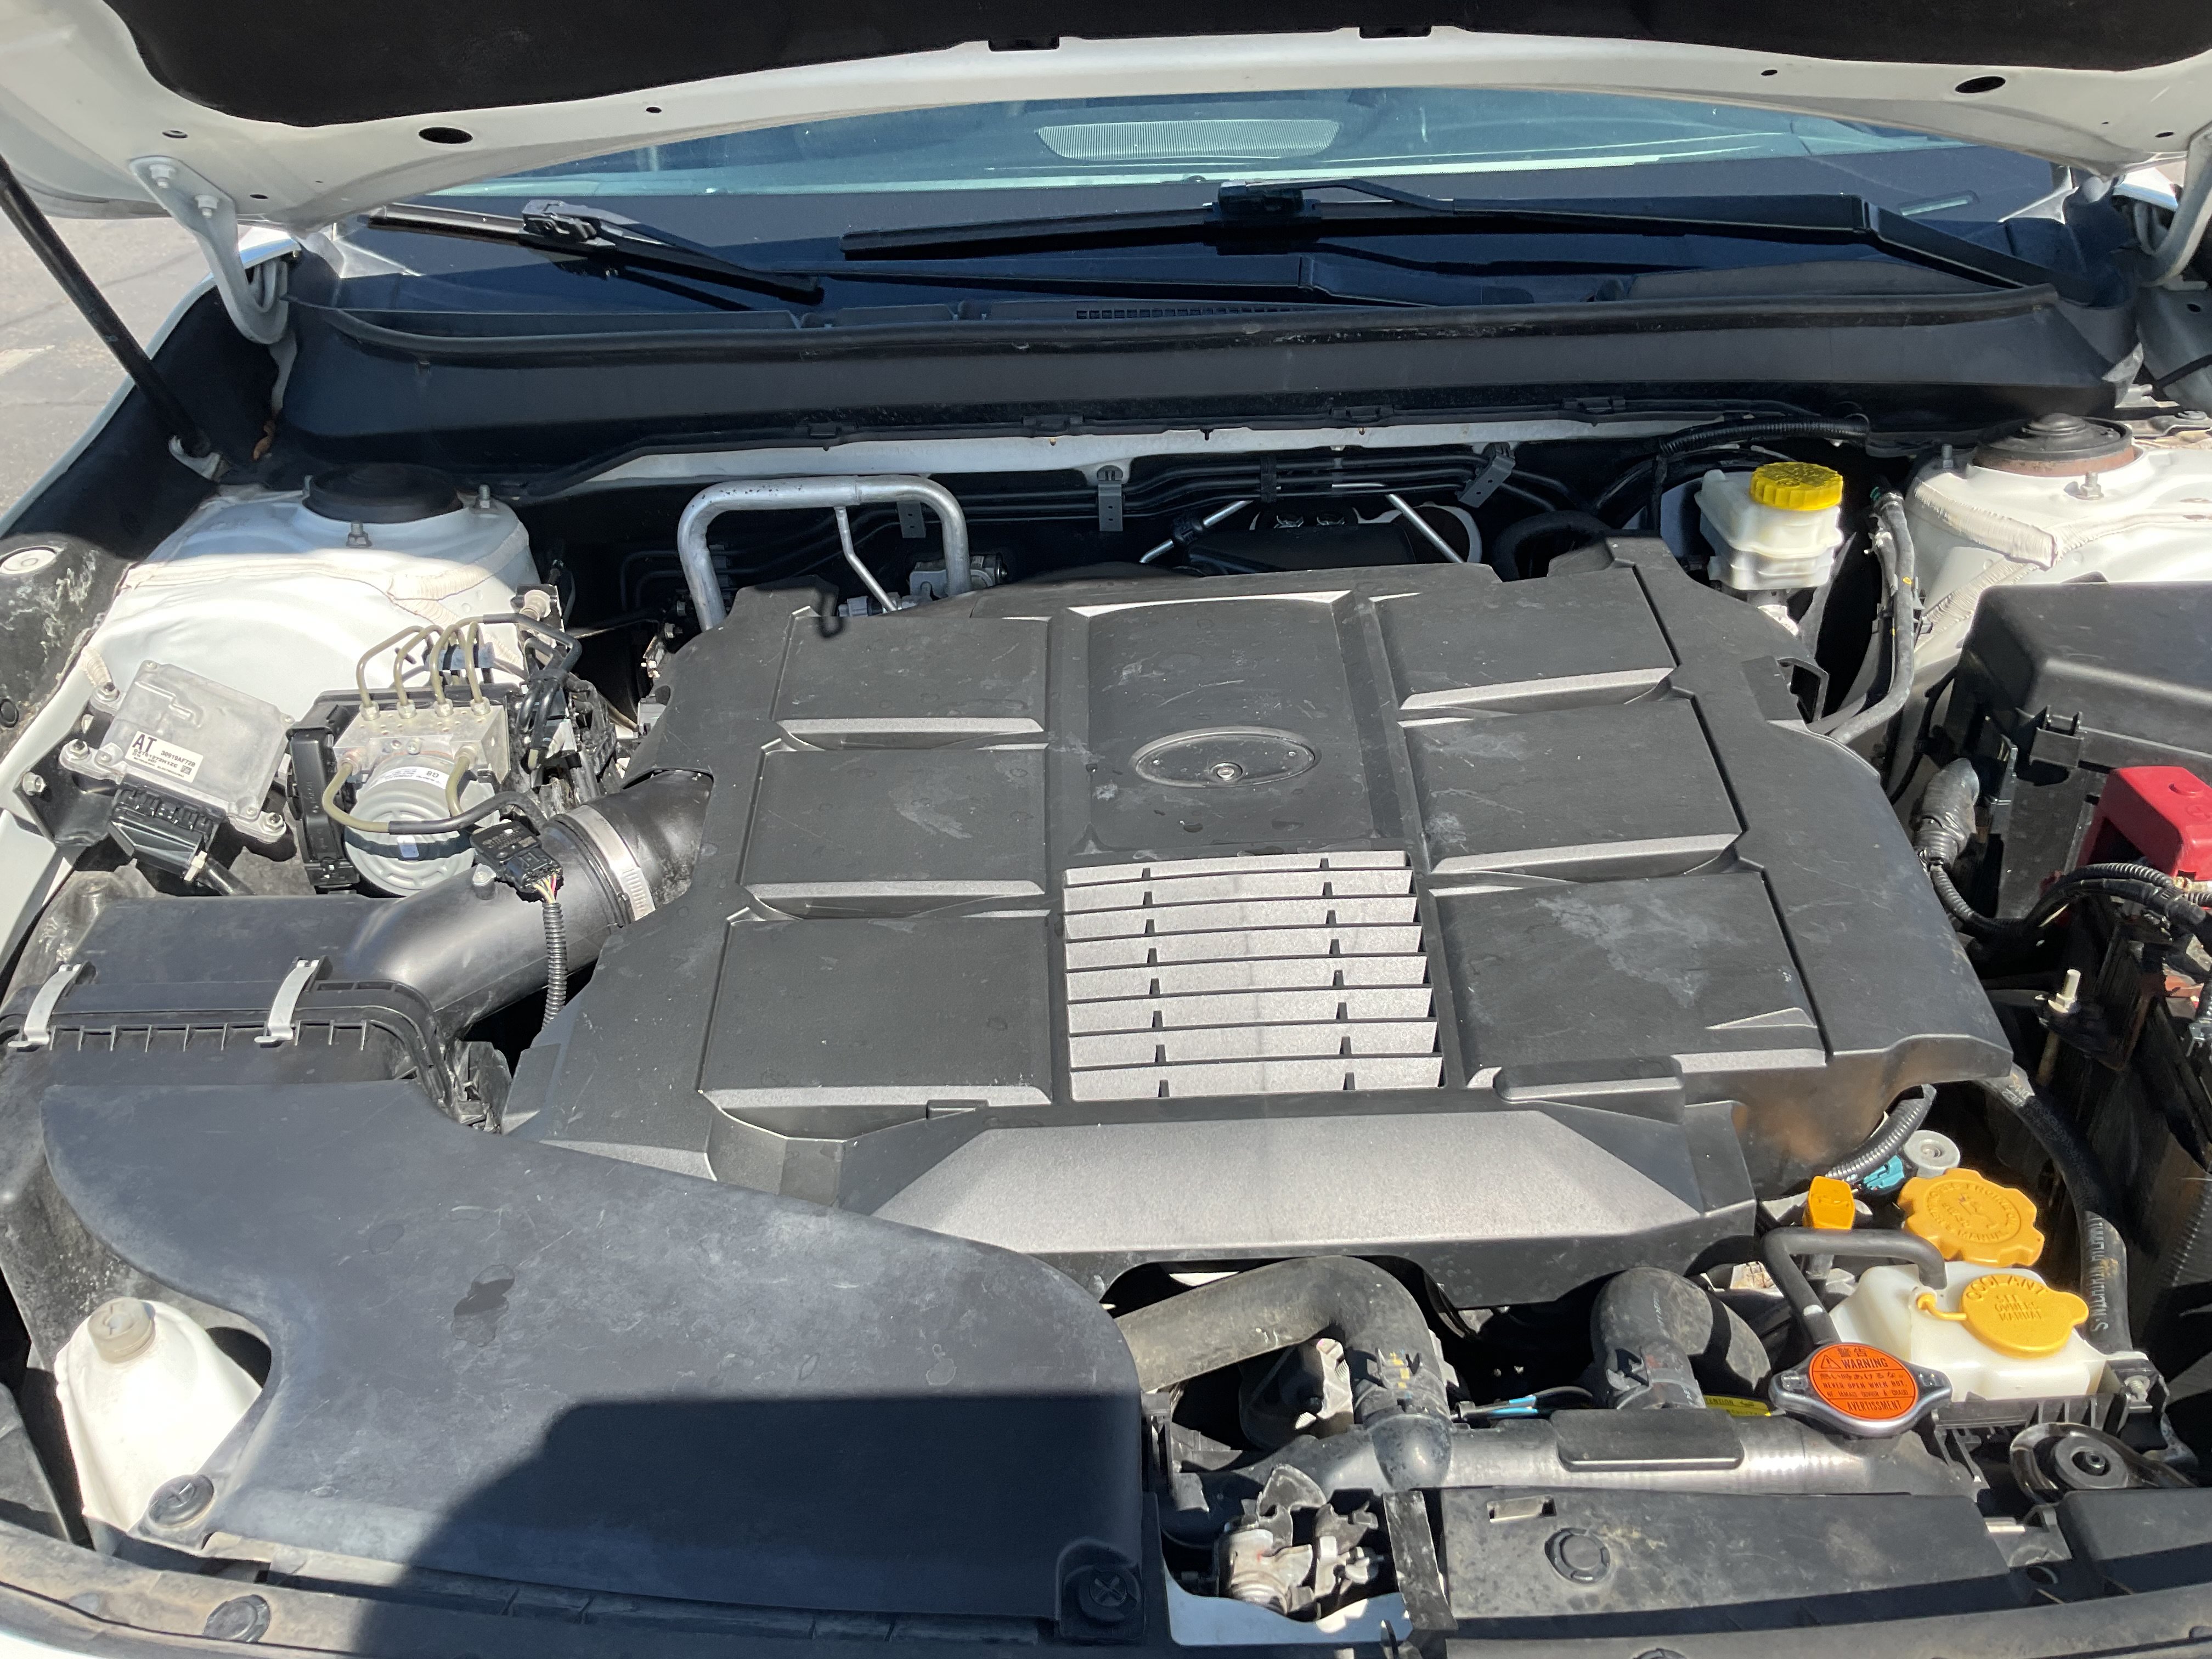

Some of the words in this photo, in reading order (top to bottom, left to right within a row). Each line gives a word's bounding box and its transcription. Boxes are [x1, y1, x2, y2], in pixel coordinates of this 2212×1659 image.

[132, 733, 157, 753] AT
[1966, 1275, 2049, 1301] COOLANT
[1996, 1294, 2019, 1304] SEE
[1999, 1311, 2042, 1322] MANUAL
[1841, 1358, 1888, 1369] WARNING
[1847, 1400, 1902, 1412] AVERTISSMENT
